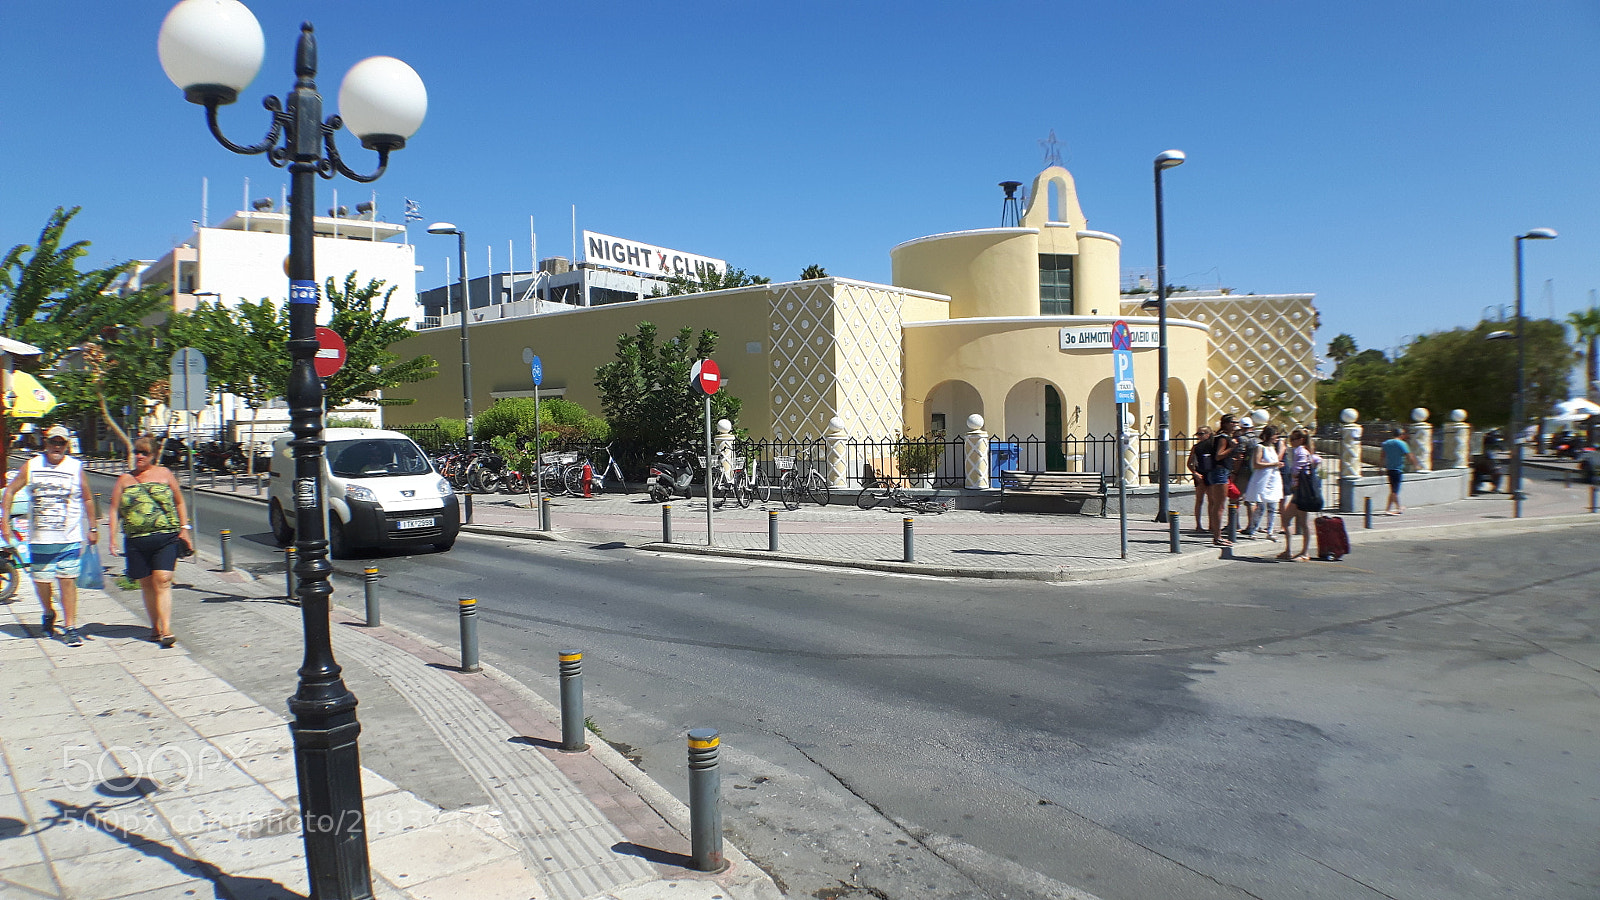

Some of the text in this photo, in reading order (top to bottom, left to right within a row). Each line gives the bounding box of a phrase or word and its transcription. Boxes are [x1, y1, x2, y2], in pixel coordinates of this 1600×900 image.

[588, 236, 652, 268] NIGHT
[1079, 332, 1112, 343] ΔΗΜΟΤΙ
[1118, 353, 1129, 380] P
